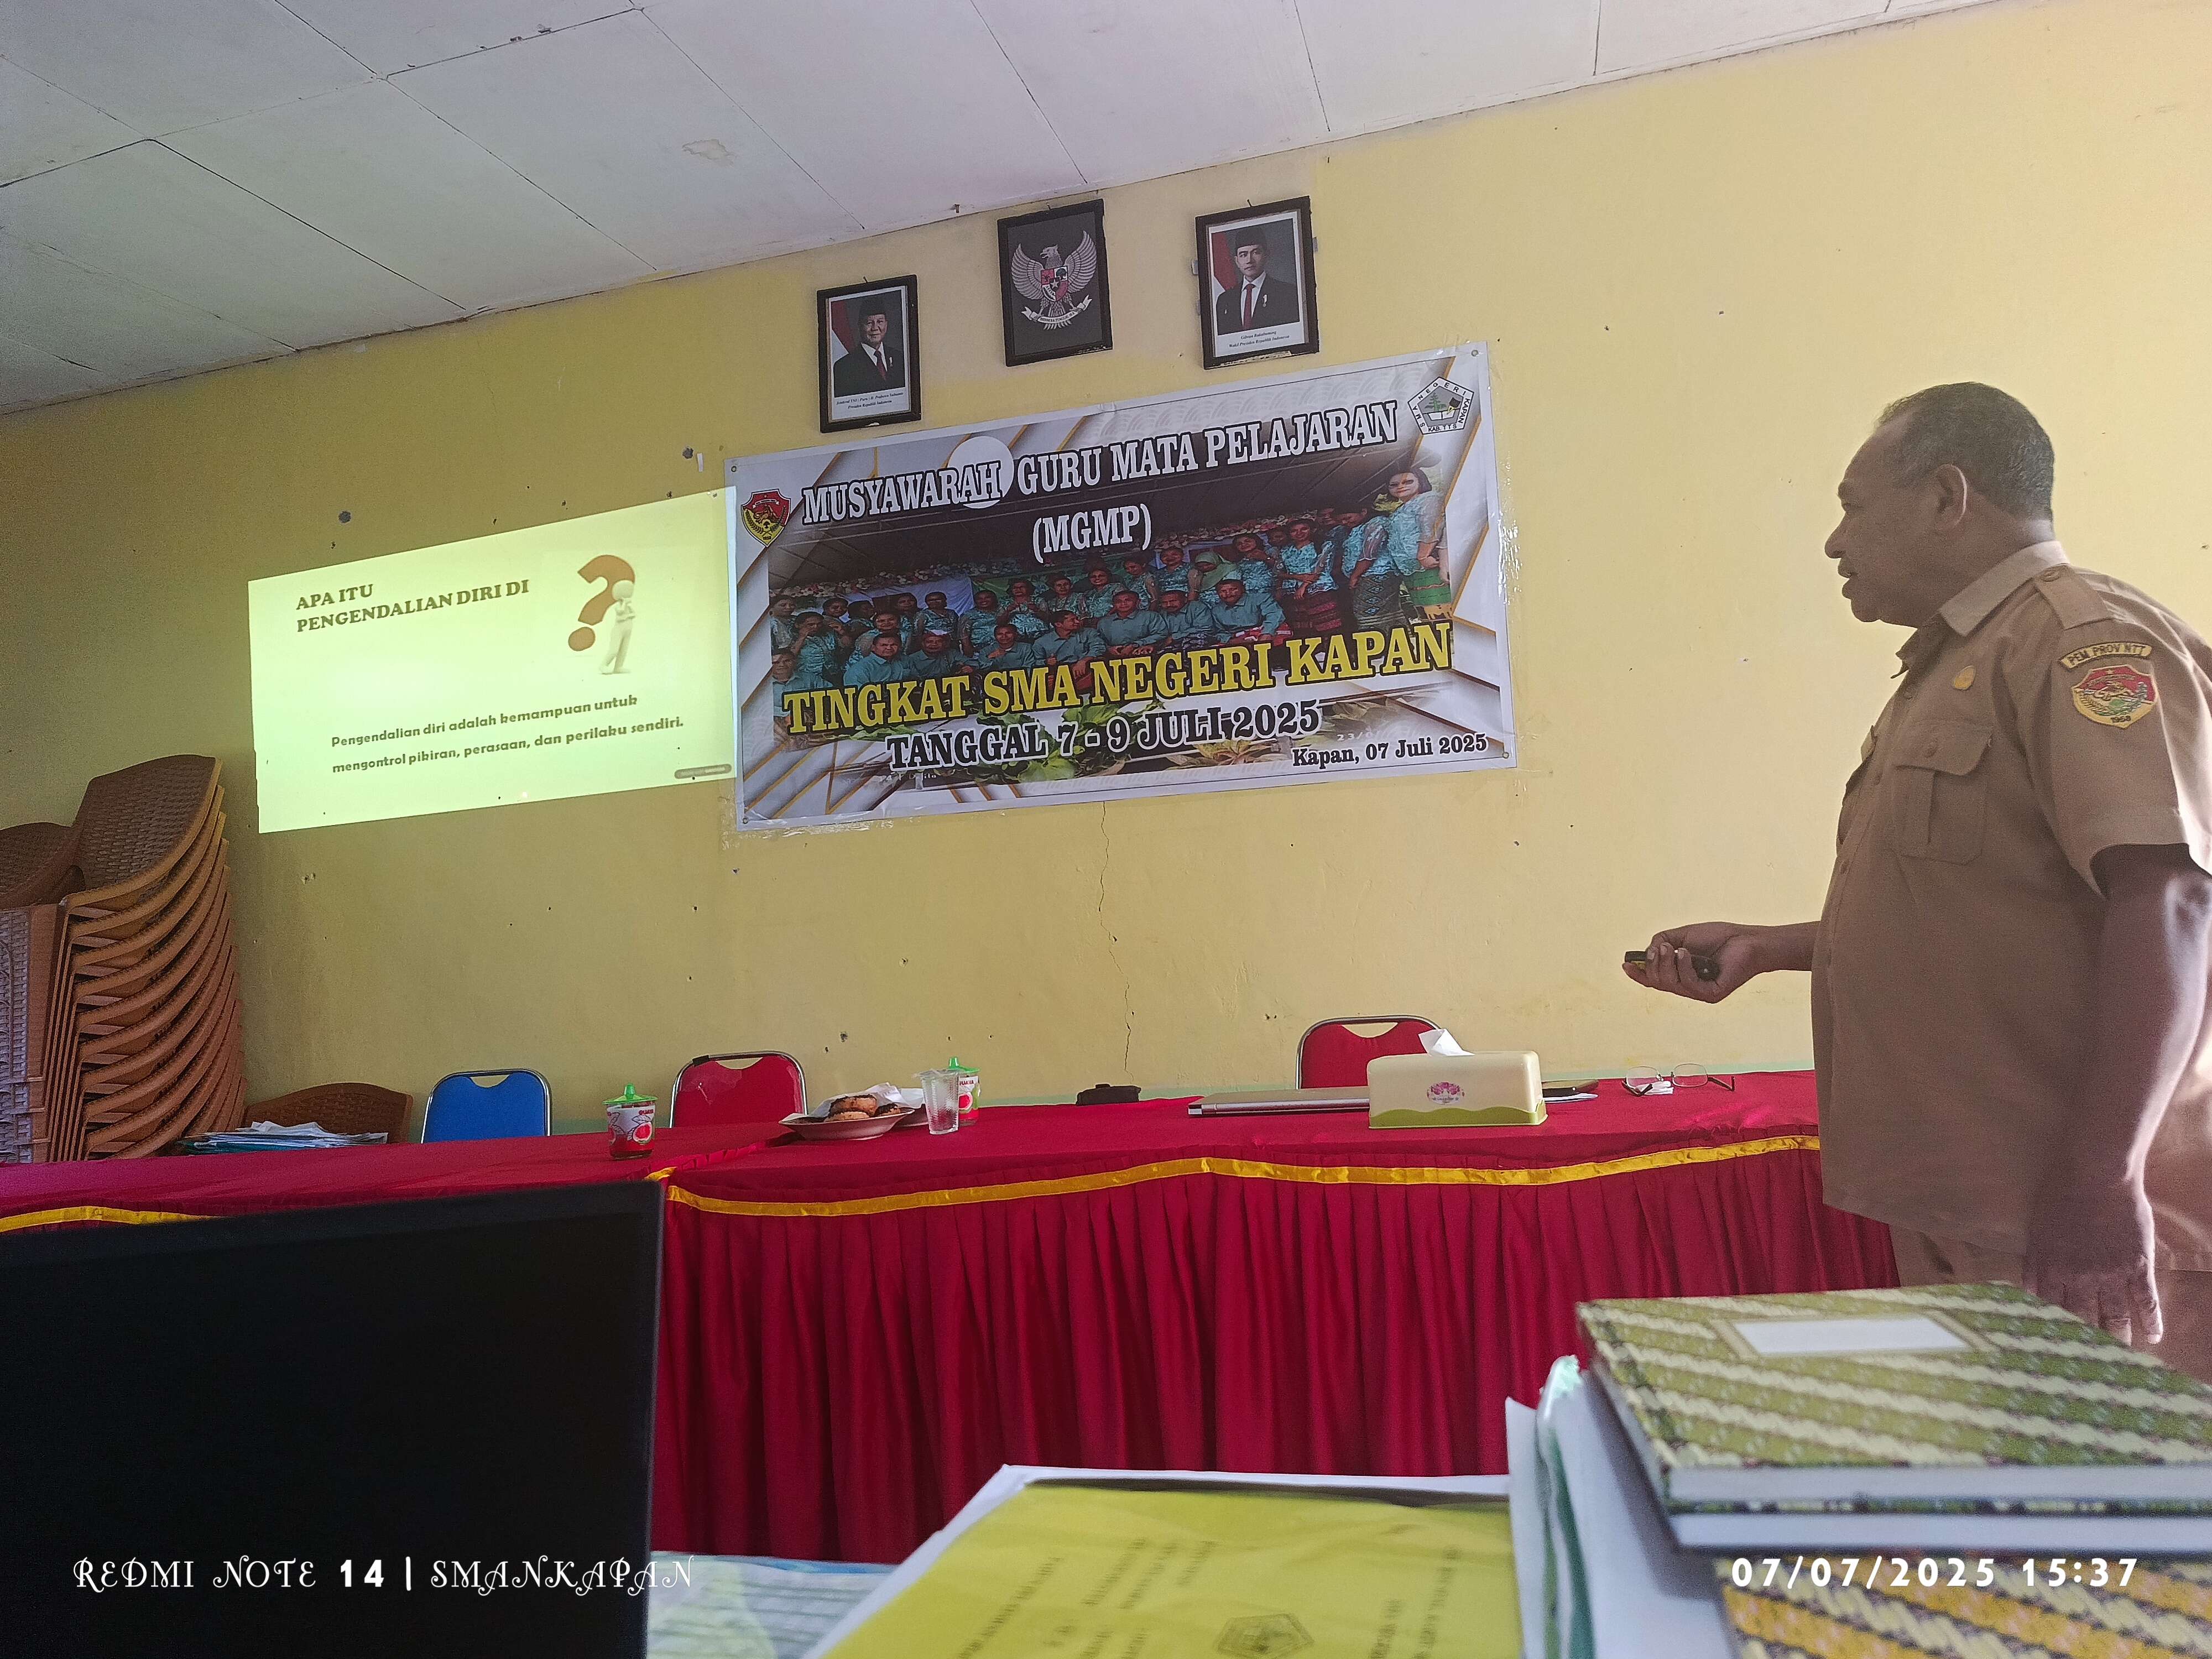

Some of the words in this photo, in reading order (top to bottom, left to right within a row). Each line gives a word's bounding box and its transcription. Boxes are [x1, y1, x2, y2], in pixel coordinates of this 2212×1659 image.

[803, 462, 1002, 524] MUSYAWARAH
[1017, 446, 1103, 495] GURU
[1110, 437, 1198, 482] MATA
[1205, 401, 1397, 468] PELAJARAN
[1032, 504, 1152, 564] (MGMP)
[296, 592, 335, 610] APA
[338, 583, 373, 602] ITU
[297, 593, 453, 632] PENGENDALIAN
[456, 584, 502, 605] DIRI
[505, 579, 530, 597] DI
[783, 674, 970, 734] TINGKAT
[983, 664, 1081, 714] SMA
[1092, 641, 1274, 703] NEGERI
[1286, 622, 1452, 686] KAPAN
[2067, 649, 2090, 665] PEM
[2093, 644, 2121, 656] PROV
[332, 728, 420, 747] Pengendalian
[423, 722, 445, 734] diri
[448, 715, 497, 731] adalah
[500, 704, 592, 724] kemampuan
[594, 695, 638, 711] untuk
[332, 753, 406, 773] mengontrol
[409, 750, 460, 765] pikiran,
[464, 740, 530, 758] perasaan,
[534, 735, 561, 747] dan
[566, 726, 627, 744] perilaku
[631, 716, 684, 733] sendiri.
[886, 722, 1047, 770] TANGGAL
[1057, 721, 1079, 756] 7
[1105, 716, 1131, 753] 9
[1138, 706, 1222, 749] JULI
[1232, 699, 1322, 742] 2025
[1292, 747, 1359, 770] Kapan,
[1365, 743, 1389, 761] 07
[1395, 737, 1433, 758] Juli
[1439, 733, 1488, 755] 2025
